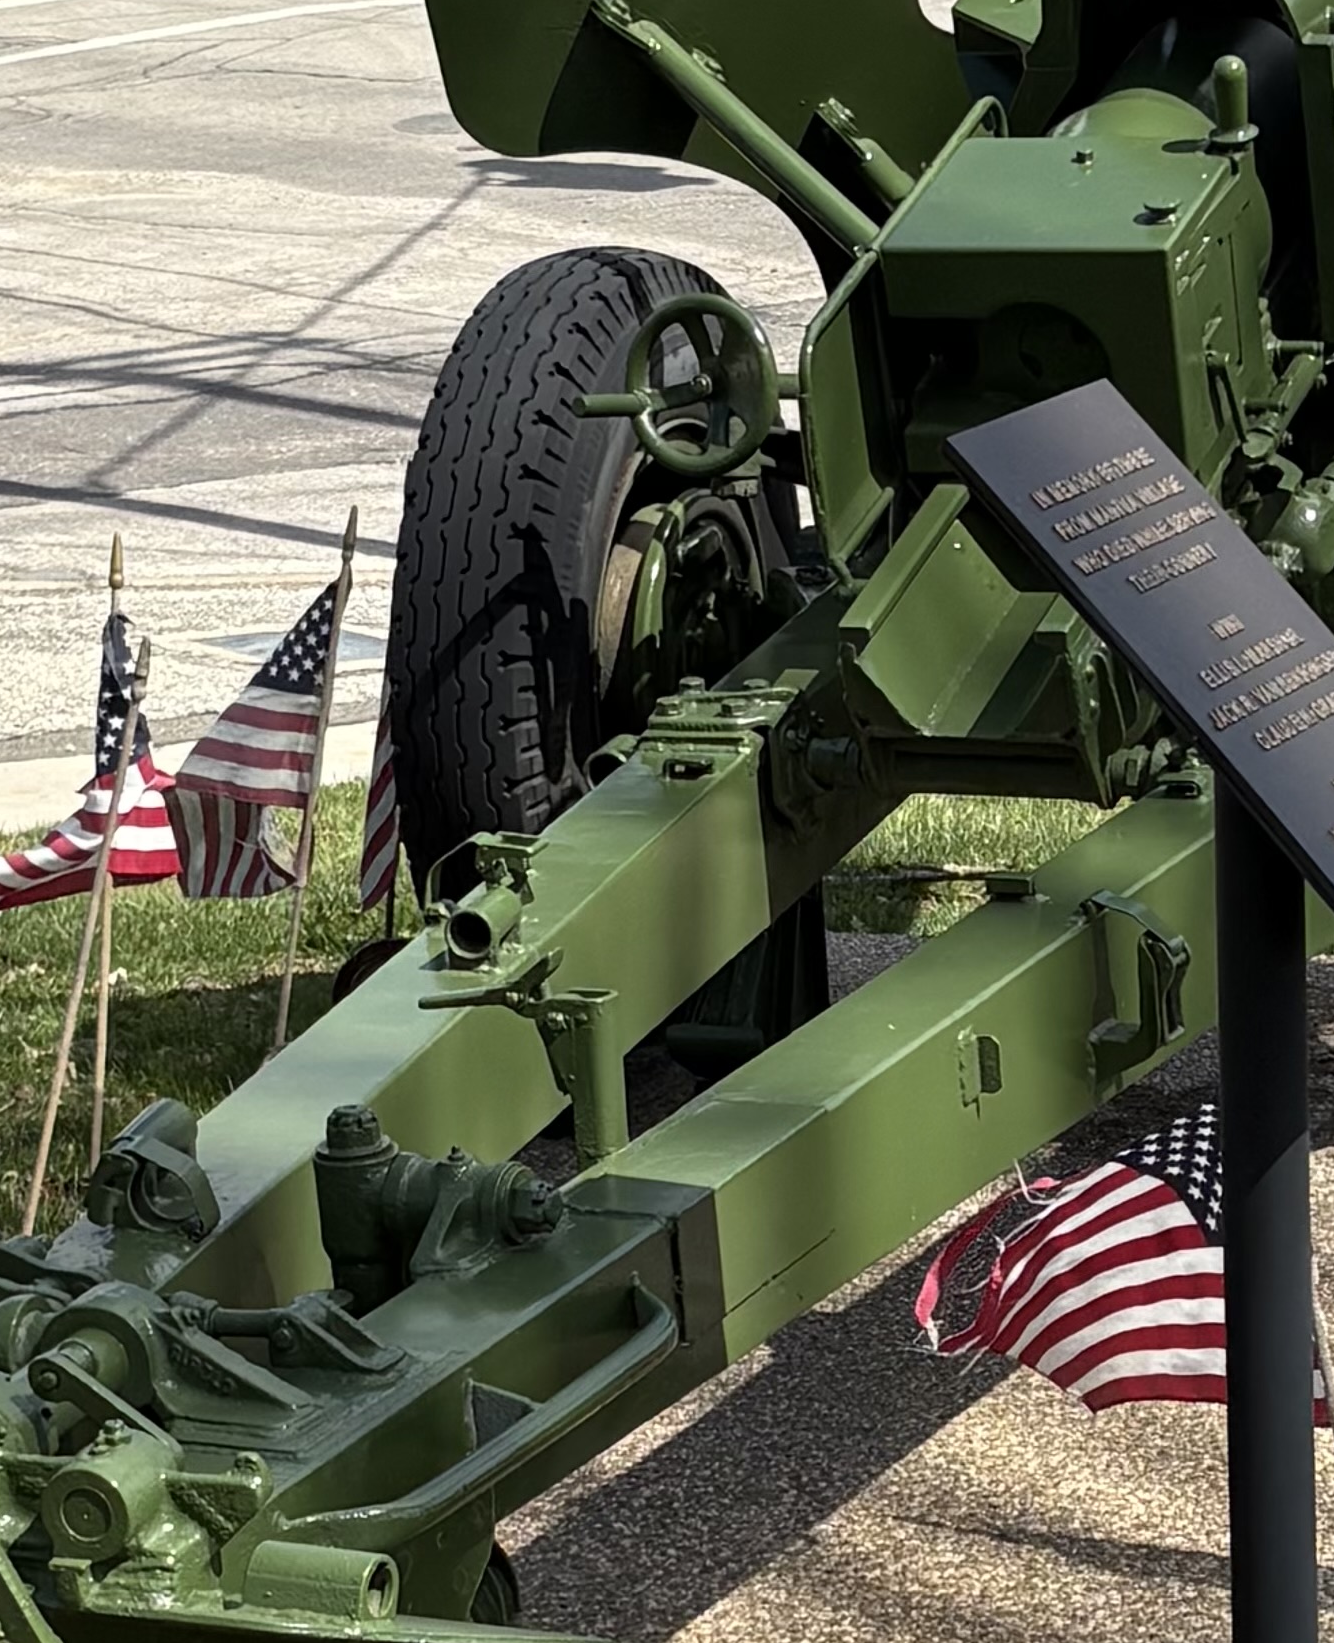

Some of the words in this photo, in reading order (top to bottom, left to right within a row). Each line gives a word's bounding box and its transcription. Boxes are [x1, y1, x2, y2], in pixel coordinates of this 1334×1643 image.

[1053, 512, 1095, 540] FROM
[1087, 492, 1141, 525] MANTUA
[1073, 548, 1109, 574] WHO
[1198, 657, 1240, 687] ELLIS
[1207, 698, 1247, 728] JACK
